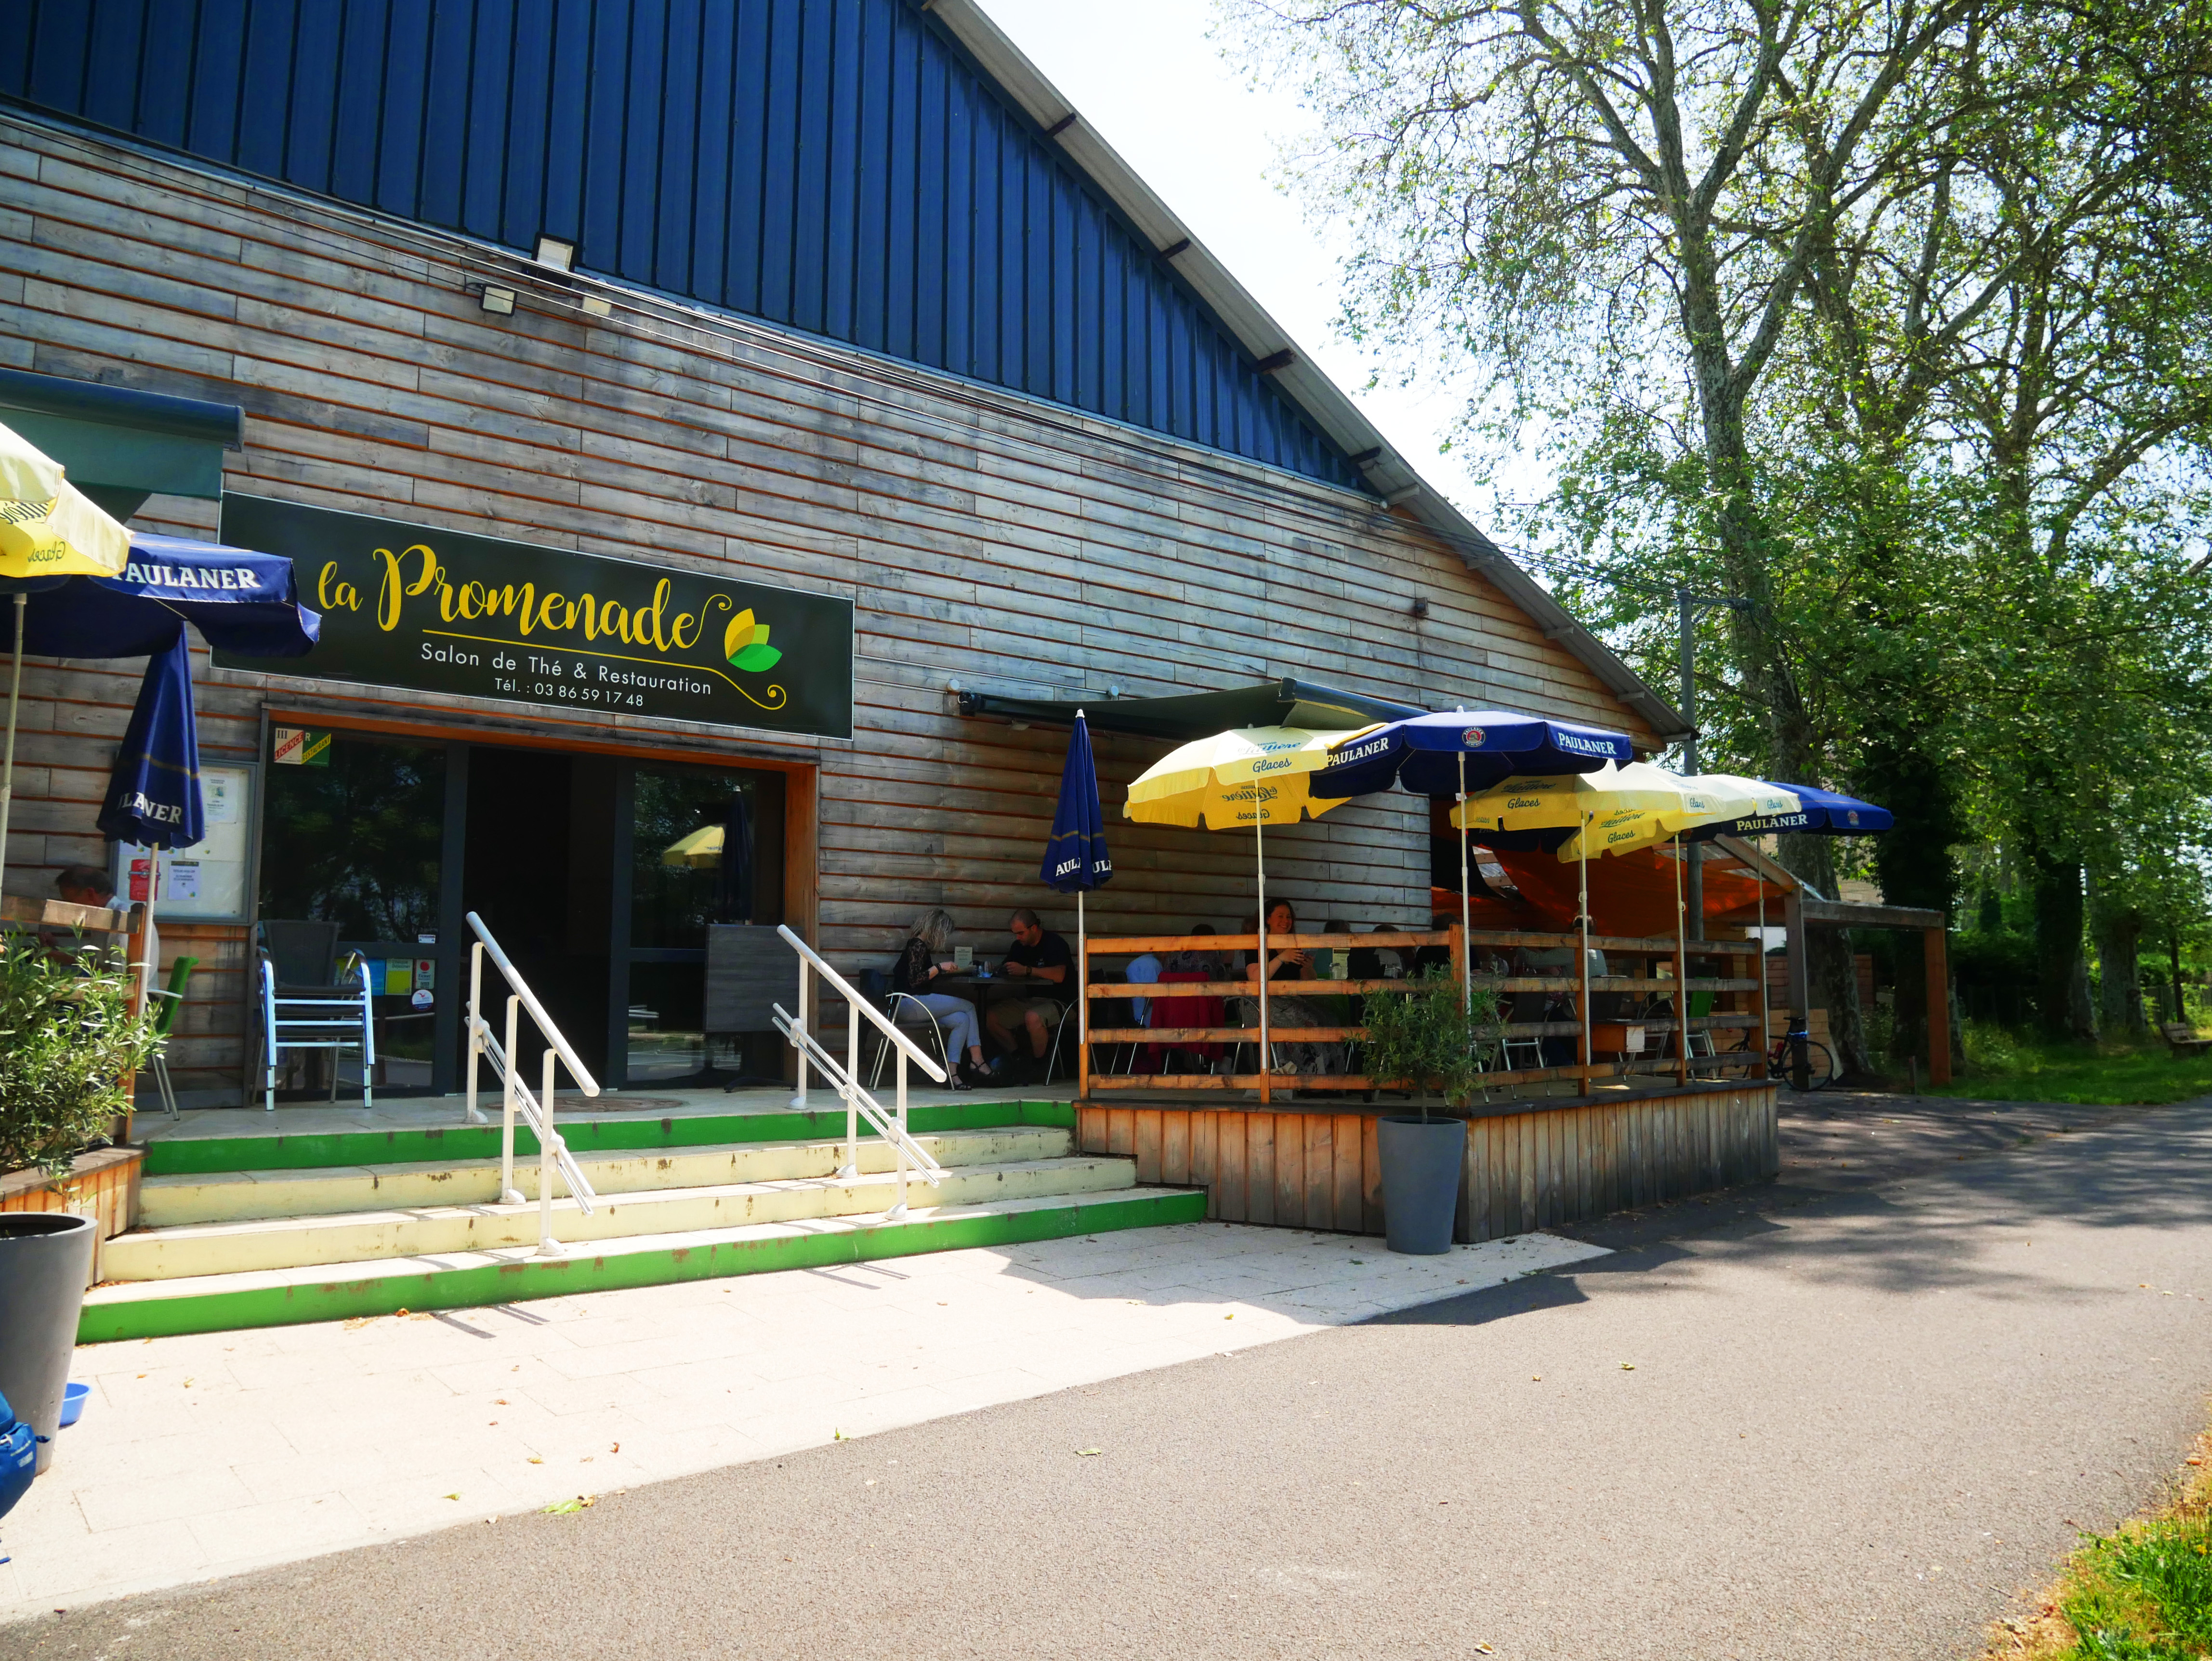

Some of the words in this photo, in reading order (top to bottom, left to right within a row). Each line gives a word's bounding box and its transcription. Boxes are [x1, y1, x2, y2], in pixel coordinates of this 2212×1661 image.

[318, 561, 363, 611] la
[372, 544, 732, 651] Promenade
[421, 643, 479, 666] Salon
[492, 651, 516, 670] de
[528, 657, 562, 676] Thé
[574, 662, 587, 679] &
[599, 665, 711, 695] Restauration
[535, 683, 553, 696] 03
[559, 685, 577, 699] 86
[581, 688, 599, 701] 59
[606, 691, 622, 703] 17
[626, 694, 643, 706] 48
[275, 732, 303, 759] LICENCE
[305, 732, 311, 741] R
[1558, 732, 1617, 754] PAULANER
[1327, 737, 1389, 767] PAULANER
[1253, 758, 1292, 773] Glaces
[117, 792, 180, 824] LANER
[1508, 797, 1540, 809] Glaces
[1737, 814, 1808, 831] PAULANER
[1608, 830, 1635, 843] Glaces
